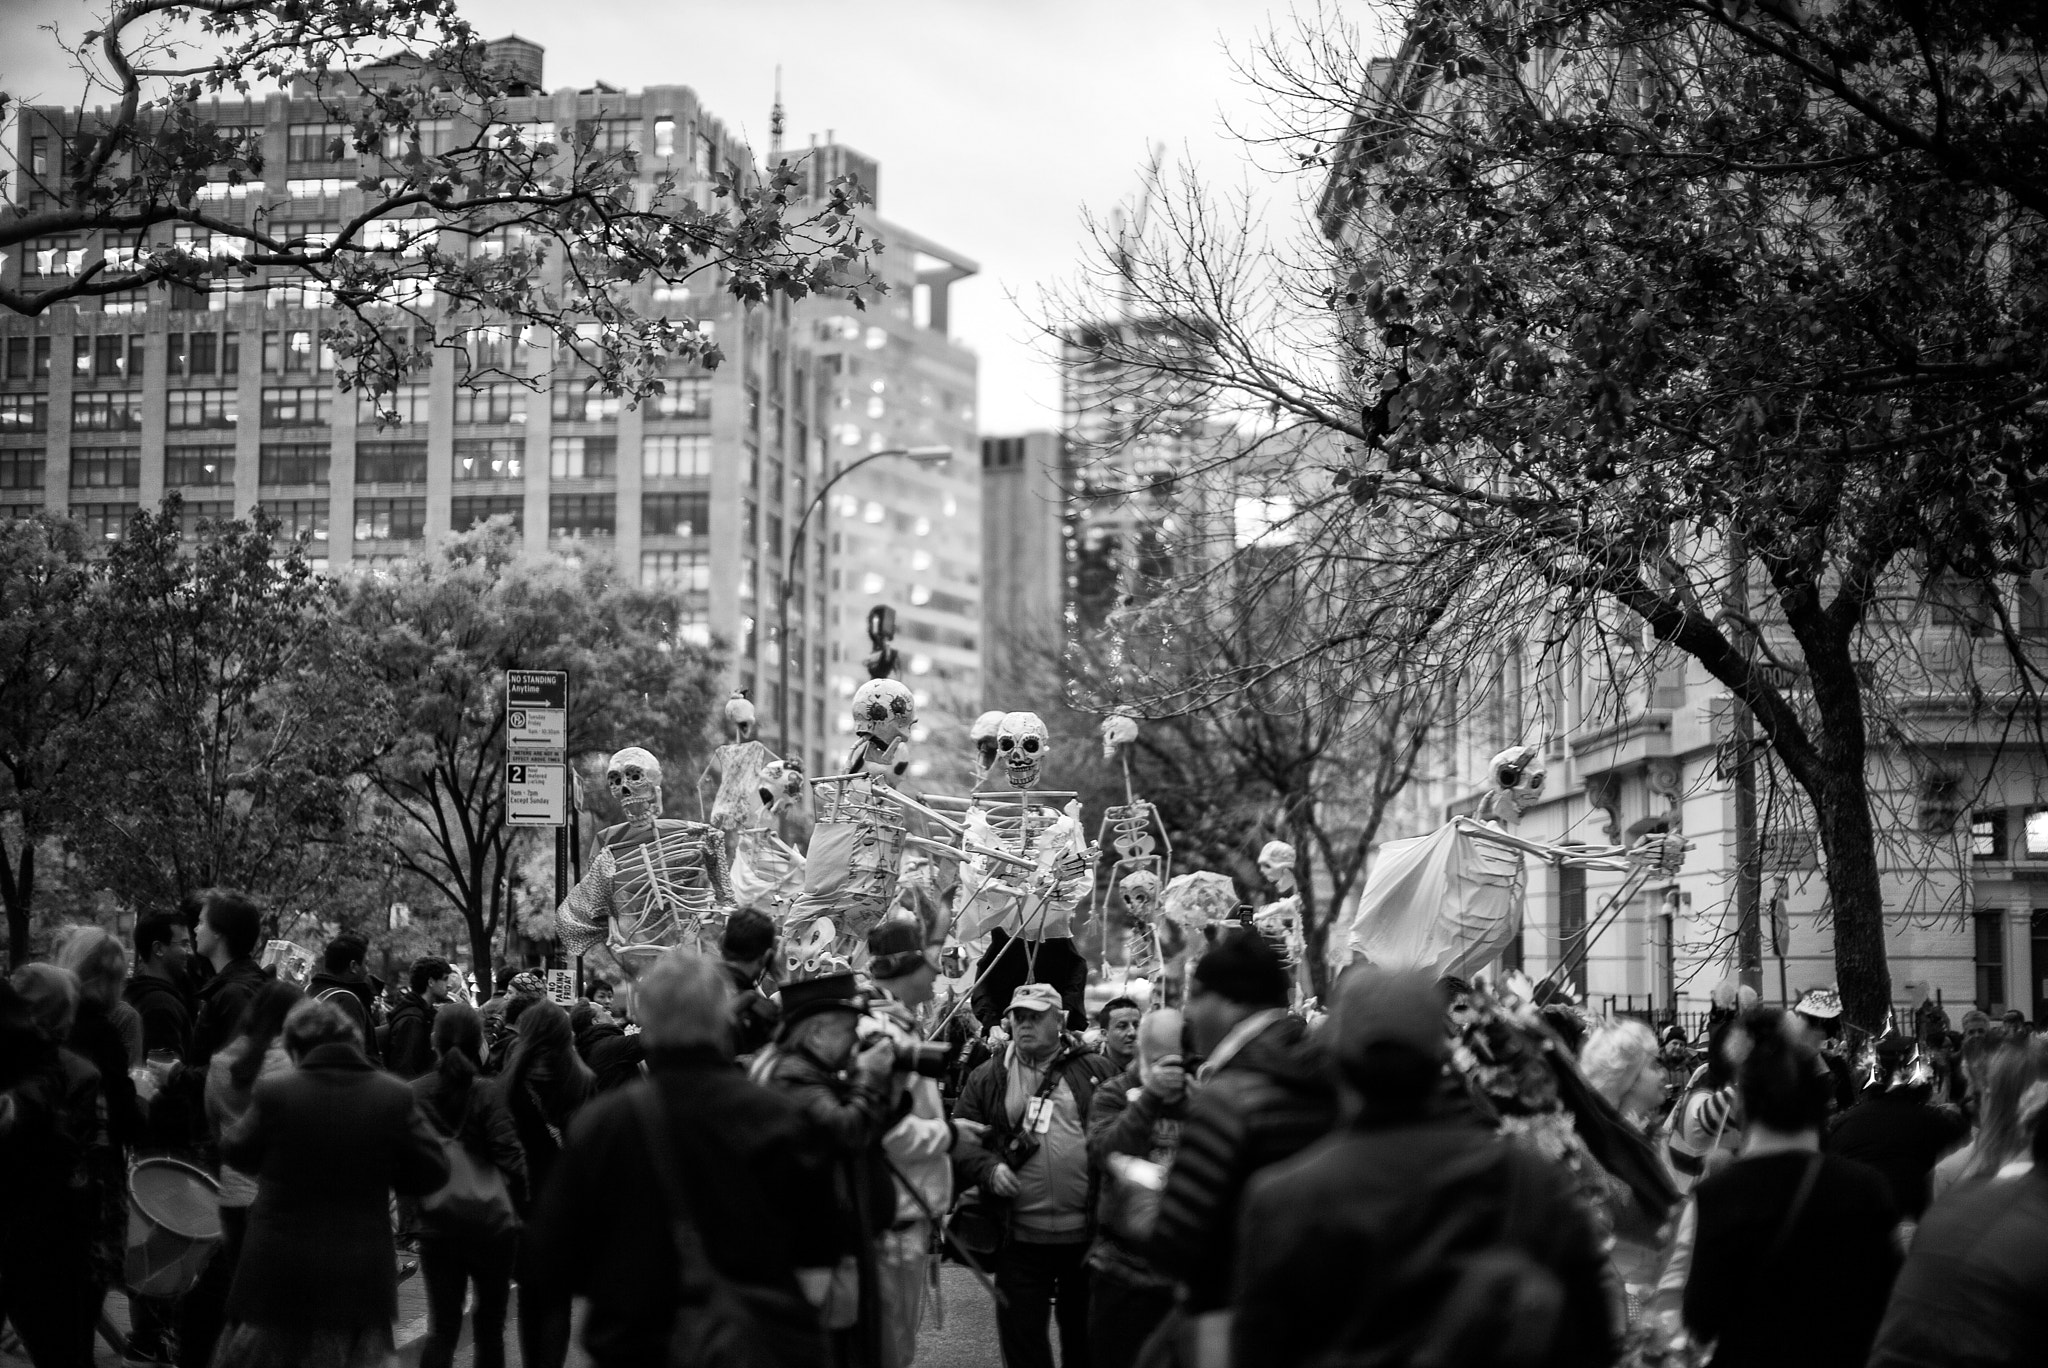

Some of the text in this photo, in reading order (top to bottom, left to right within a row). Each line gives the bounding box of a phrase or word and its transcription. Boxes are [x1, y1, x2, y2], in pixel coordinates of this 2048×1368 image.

[511, 675, 557, 684] NO STANDING
[511, 684, 540, 693] Anytime
[512, 766, 522, 782] 2
[549, 982, 555, 992] NO
[555, 972, 564, 1002] PARKING
